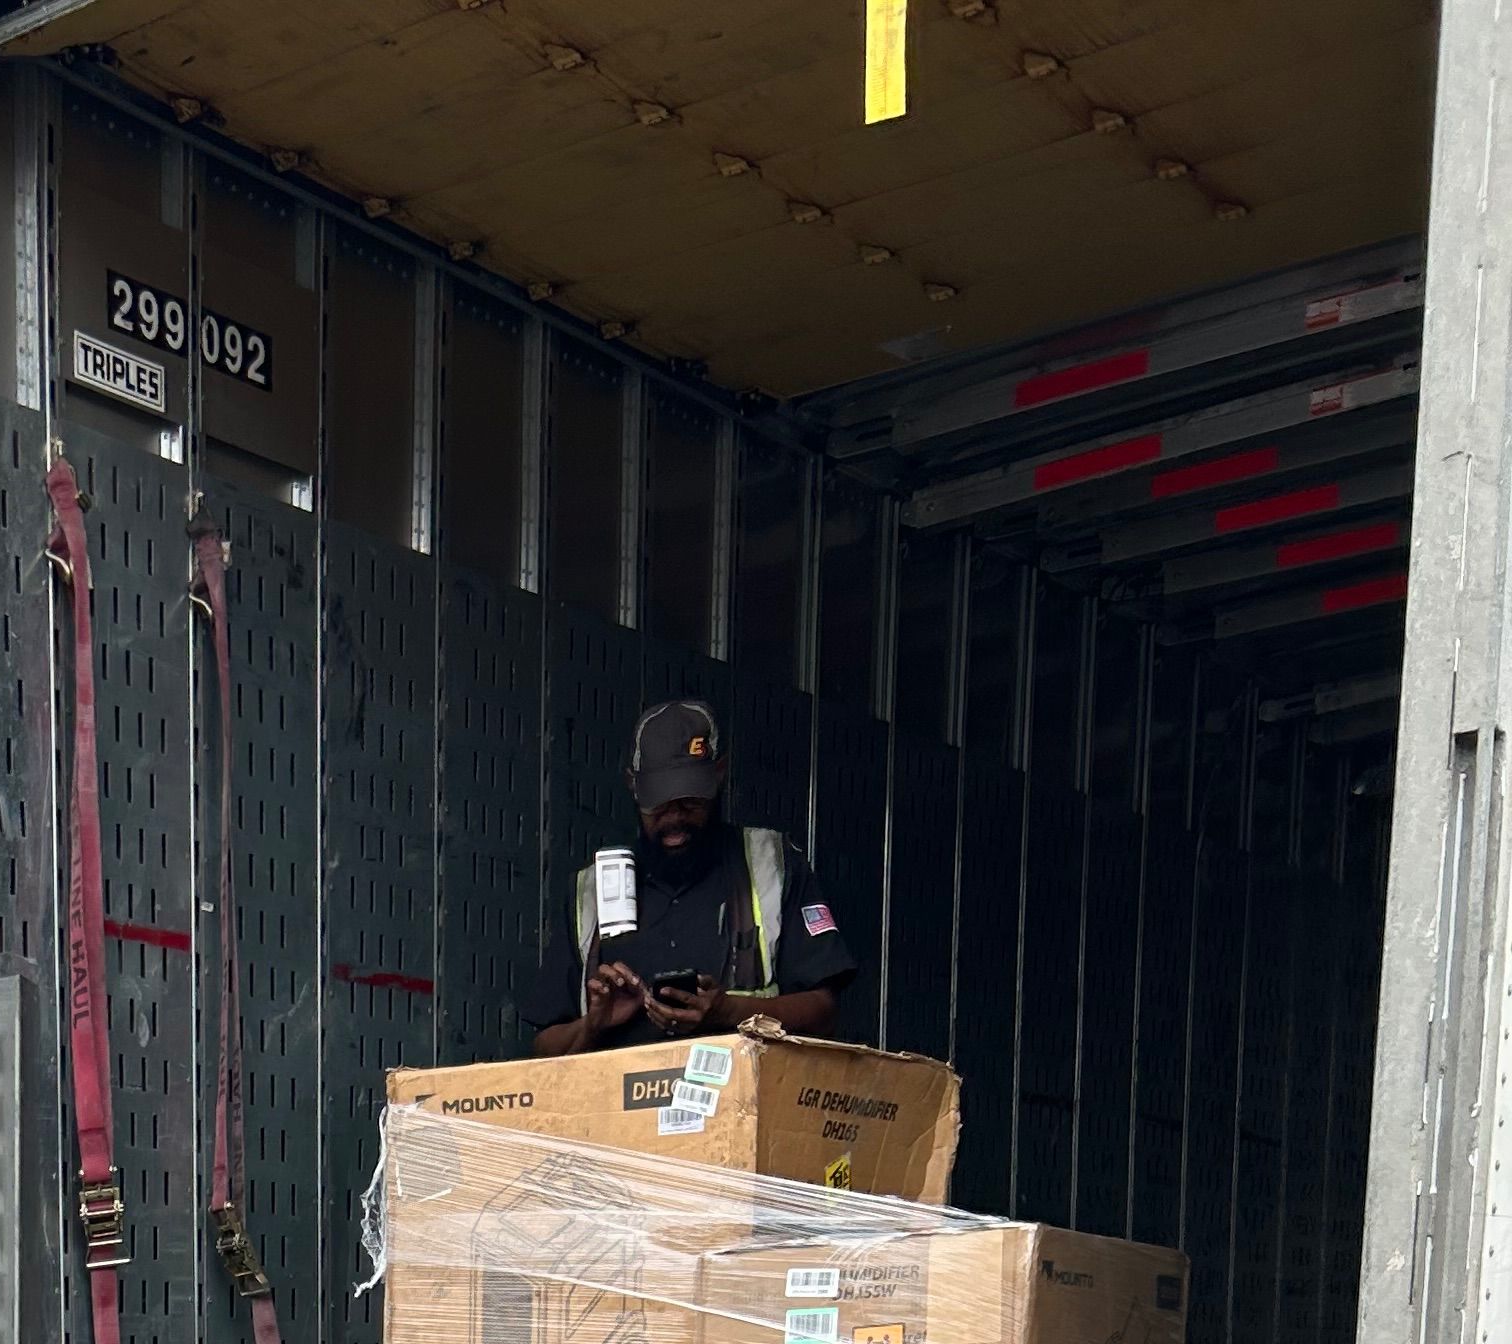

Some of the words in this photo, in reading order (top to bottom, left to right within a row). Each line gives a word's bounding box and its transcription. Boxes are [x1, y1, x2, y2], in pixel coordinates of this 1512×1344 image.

[79, 343, 159, 401] TRIPLES
[689, 737, 704, 755] E
[71, 940, 90, 1030] HAUL
[442, 1092, 534, 1115] MOUNTO
[797, 1087, 821, 1109] LGR
[821, 1090, 899, 1122] DEHUMIDIFIER
[822, 1120, 860, 1142] DH165
